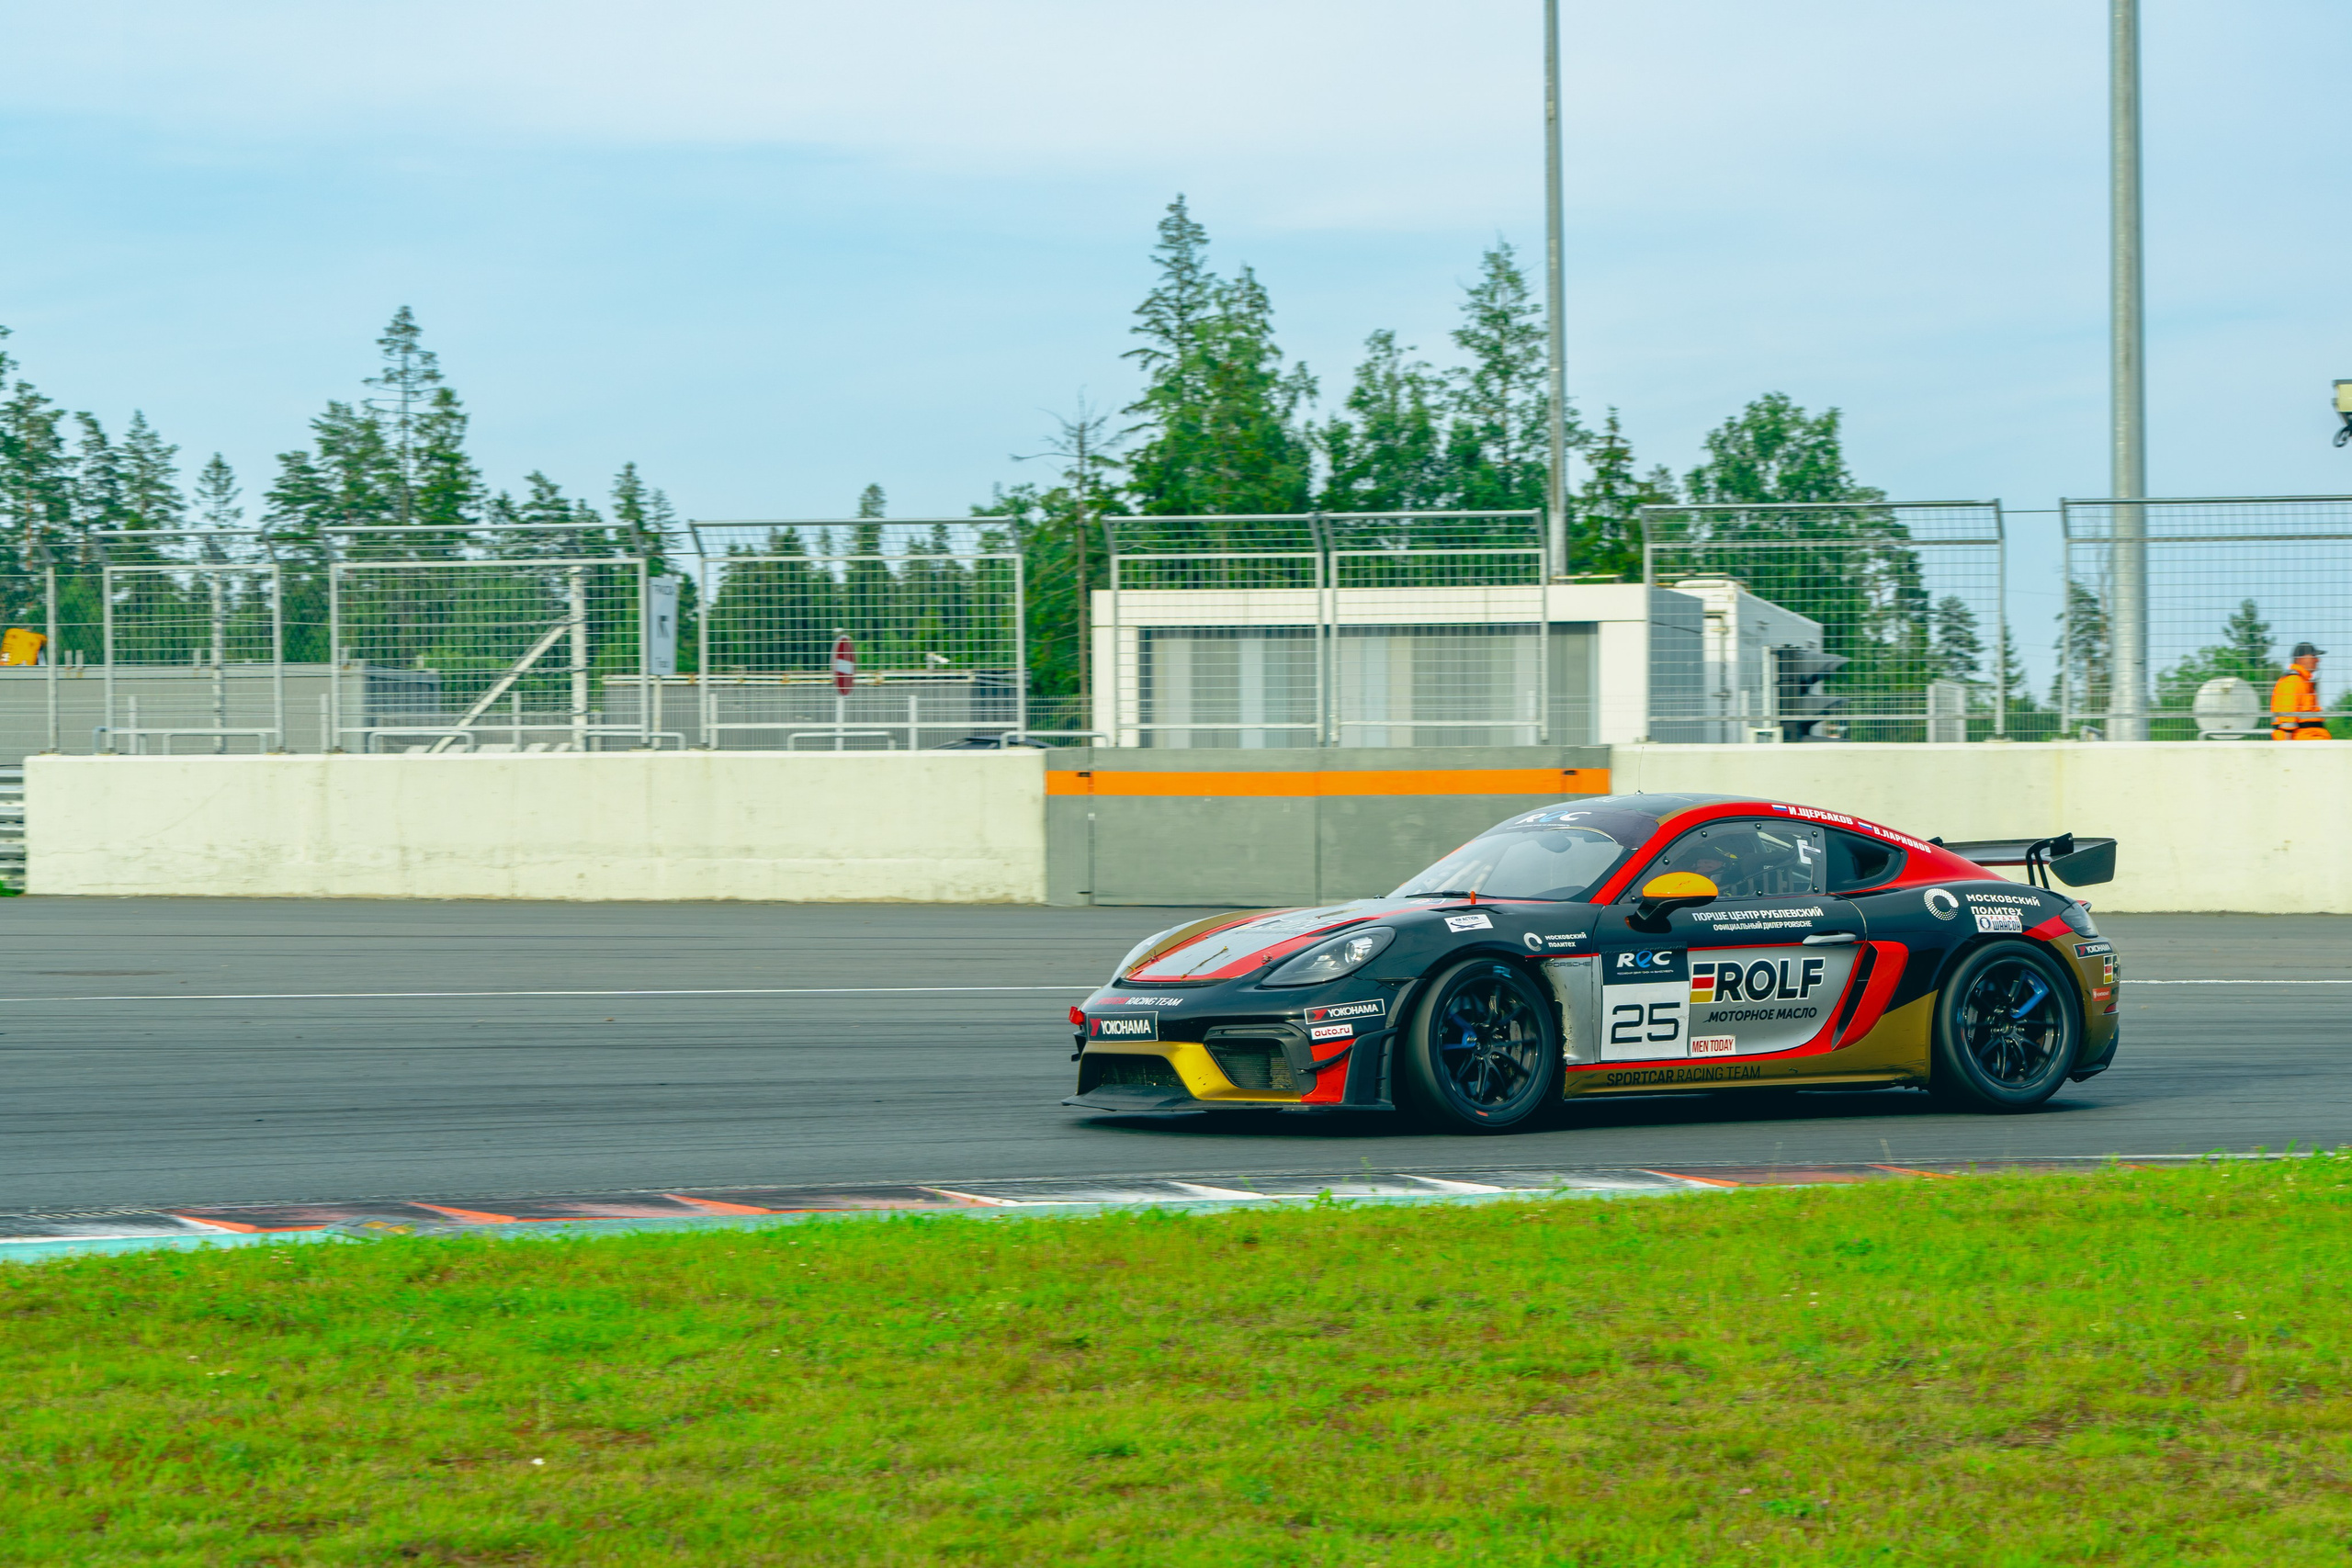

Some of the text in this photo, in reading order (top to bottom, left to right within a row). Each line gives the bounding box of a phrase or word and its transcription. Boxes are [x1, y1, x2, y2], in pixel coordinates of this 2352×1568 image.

[1788, 806, 1853, 825] И.ЩЕРБАКОВ
[1873, 827, 1931, 853] В.ЛАРИОНОВ
[1691, 906, 1824, 921] ПОРШЕ ЦЕНТР РУБЛЕВСКИЙ
[1713, 920, 1813, 931] ОФИЦИАЛЬНЫЙ ДИЛЕР PORSCHE
[1713, 956, 1826, 1003] ROLF
[1125, 997, 1157, 1006] RACING
[1155, 998, 1183, 1006] TEAM
[1328, 1003, 1379, 1017] YOKOHAMA
[1708, 1007, 1817, 1023] МОТОРНОЕ МАСЛО
[1101, 1019, 1151, 1034] YOKOHAMA
[1611, 1002, 1680, 1044] 25
[1314, 1027, 1350, 1037] auto.ru
[1691, 1039, 1734, 1053] MEN TODAY
[1607, 1065, 1760, 1087] SPORTCAR RACING TEAM
